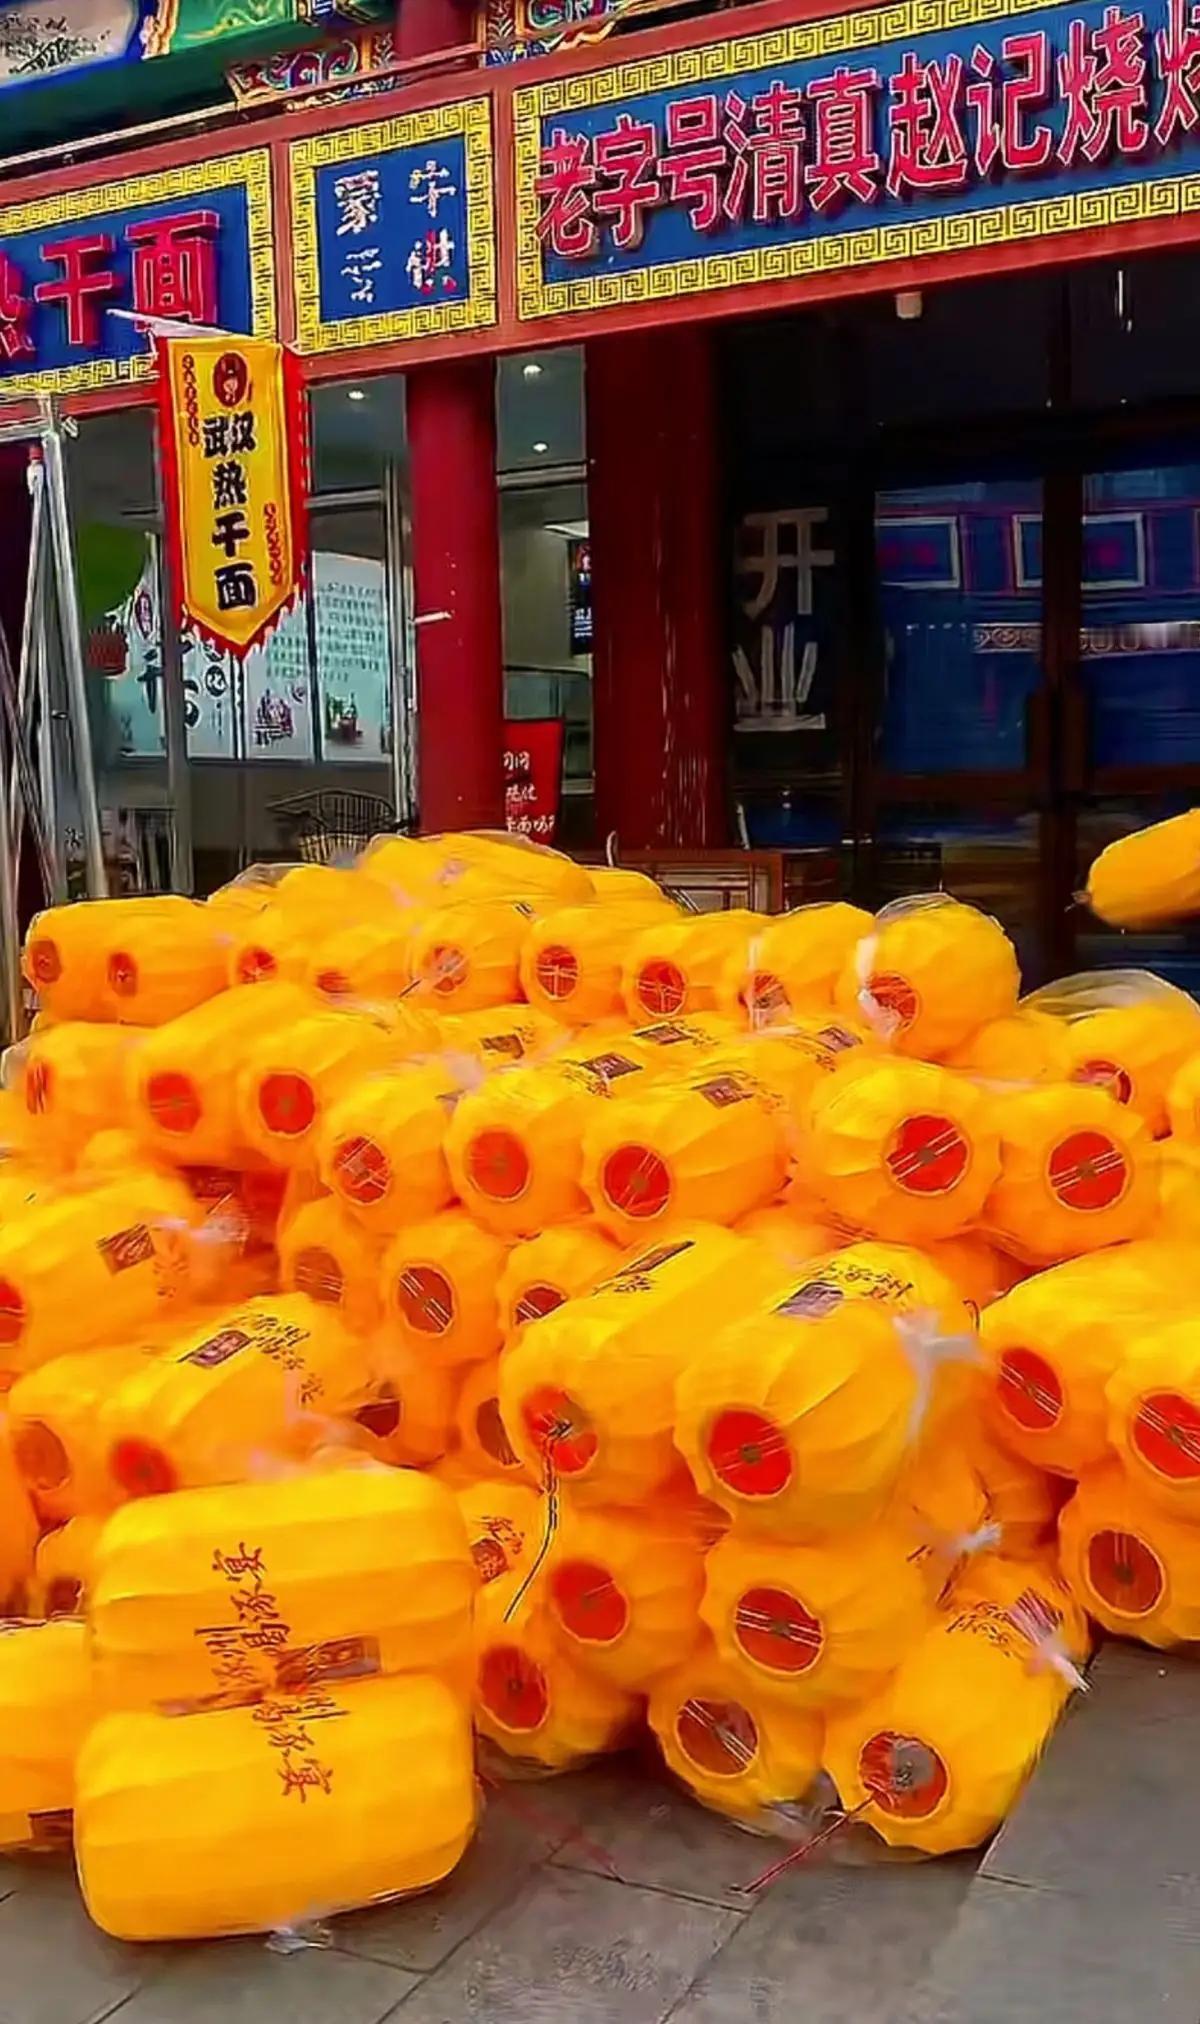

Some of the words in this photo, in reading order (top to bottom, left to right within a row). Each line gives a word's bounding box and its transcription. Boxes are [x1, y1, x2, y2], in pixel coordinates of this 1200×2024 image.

[202, 411, 256, 457] 武汉
[211, 460, 257, 611] 热干面
[731, 507, 835, 731] 开业
